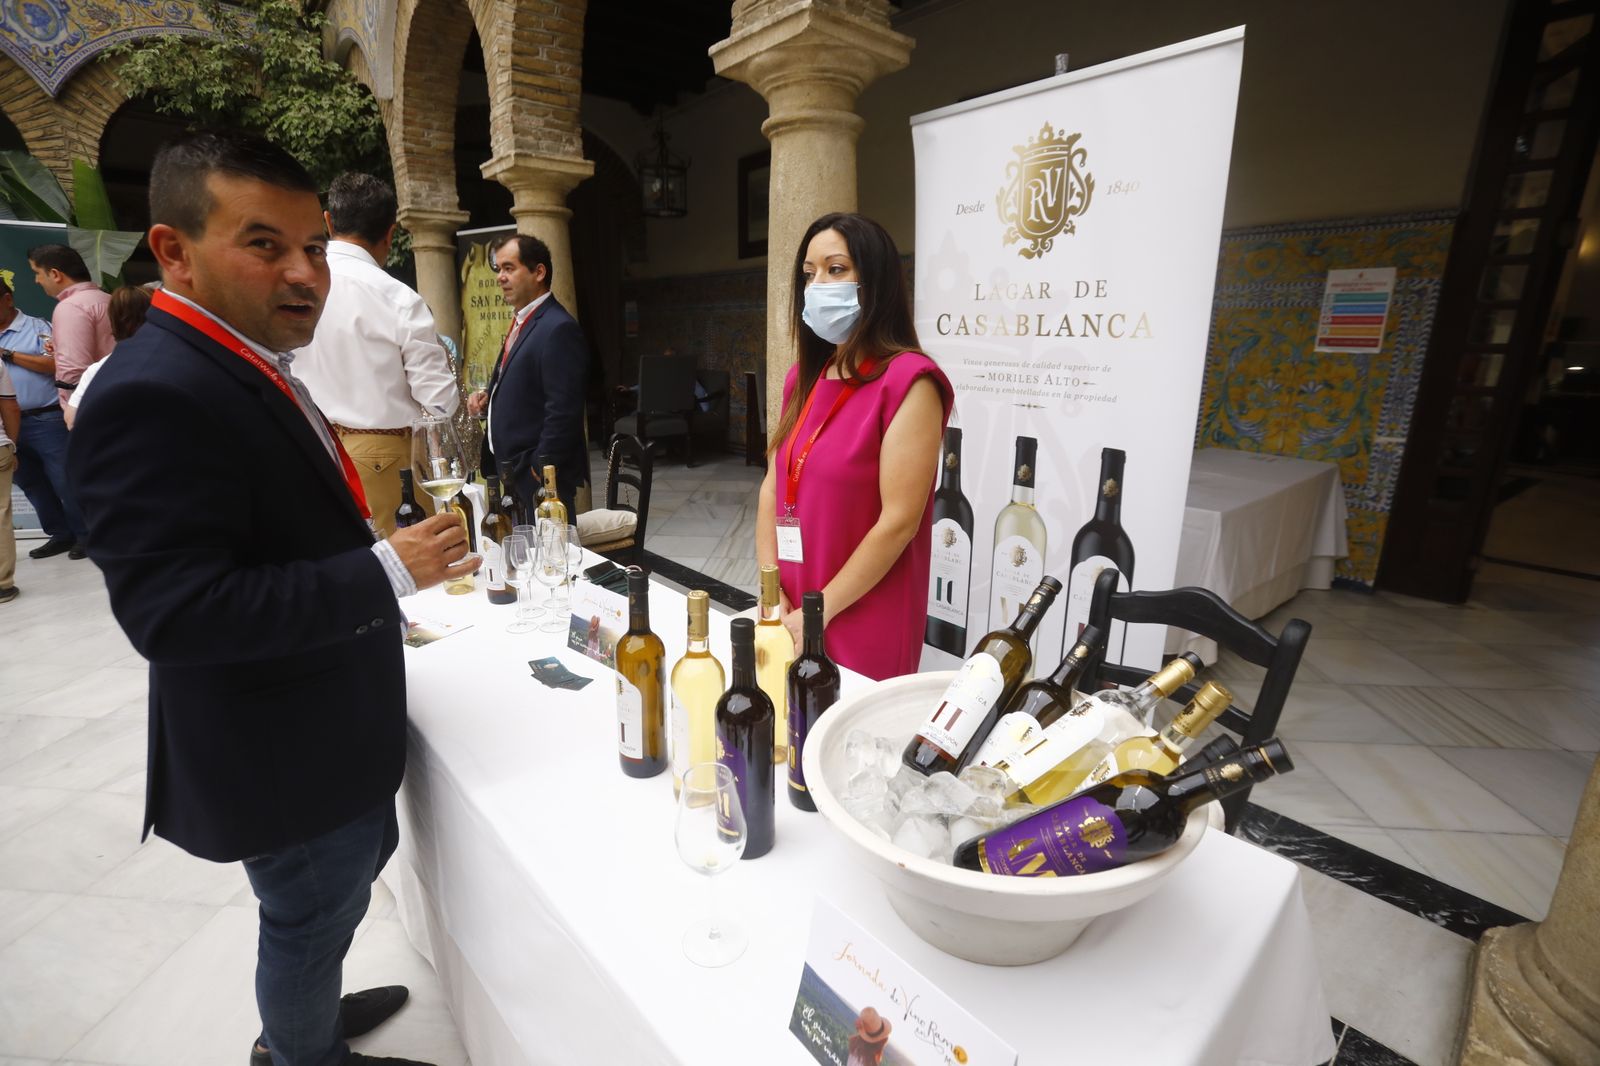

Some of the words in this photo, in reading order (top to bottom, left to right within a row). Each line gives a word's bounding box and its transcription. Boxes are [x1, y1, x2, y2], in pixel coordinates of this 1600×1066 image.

[1106, 179, 1140, 195] 1840
[956, 200, 985, 216] Desde
[478, 279, 502, 288] BODE
[974, 281, 1052, 301] LAGAR
[1075, 279, 1108, 298] DE
[471, 295, 492, 308] SAN
[494, 295, 512, 308] PA
[480, 311, 512, 320] MORILE
[936, 312, 1155, 339] CASABLANCA
[1032, 361, 1061, 370] calidad
[1063, 364, 1100, 373] superior
[1102, 364, 1112, 373] de
[988, 372, 1039, 385] MORILES
[1074, 393, 1118, 404] propiedad
